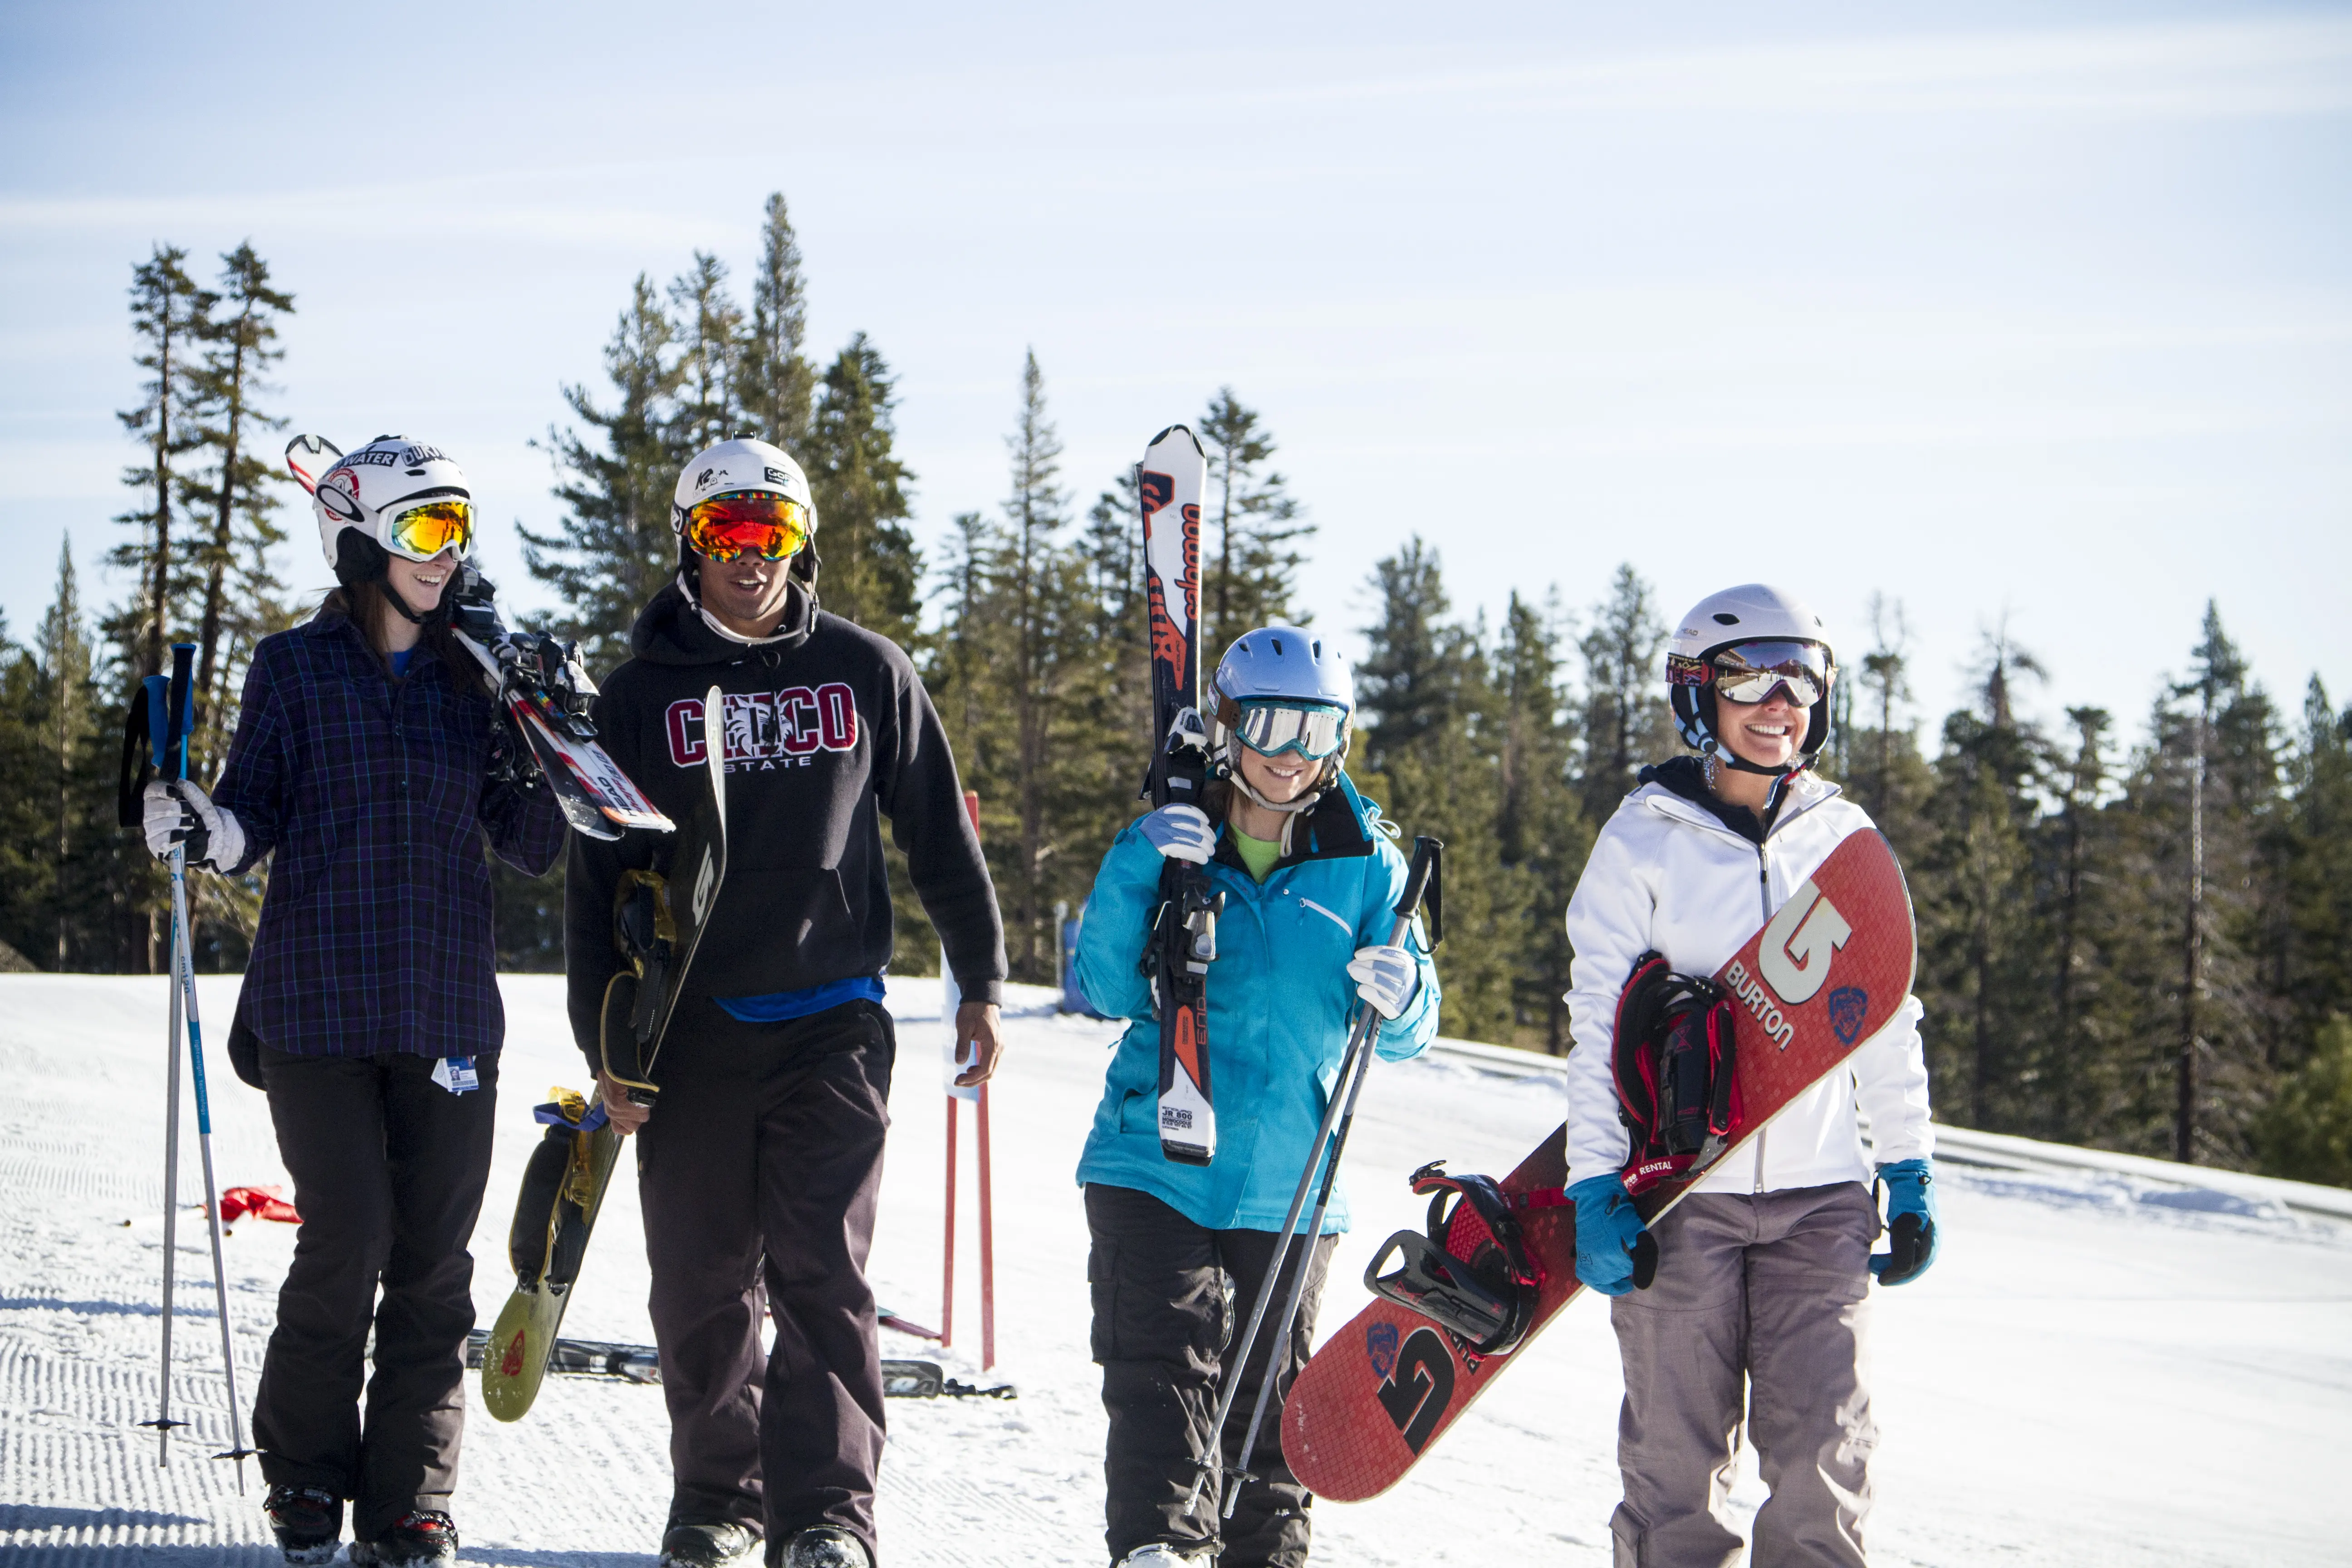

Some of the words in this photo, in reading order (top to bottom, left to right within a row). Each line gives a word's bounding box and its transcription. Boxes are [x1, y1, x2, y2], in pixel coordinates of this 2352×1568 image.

[768, 469, 792, 481] GoP
[724, 756, 811, 773] STATE
[1725, 960, 1797, 1052] BURTON
[1176, 1112, 1192, 1120] 800
[1639, 1161, 1672, 1175] RENTAL
